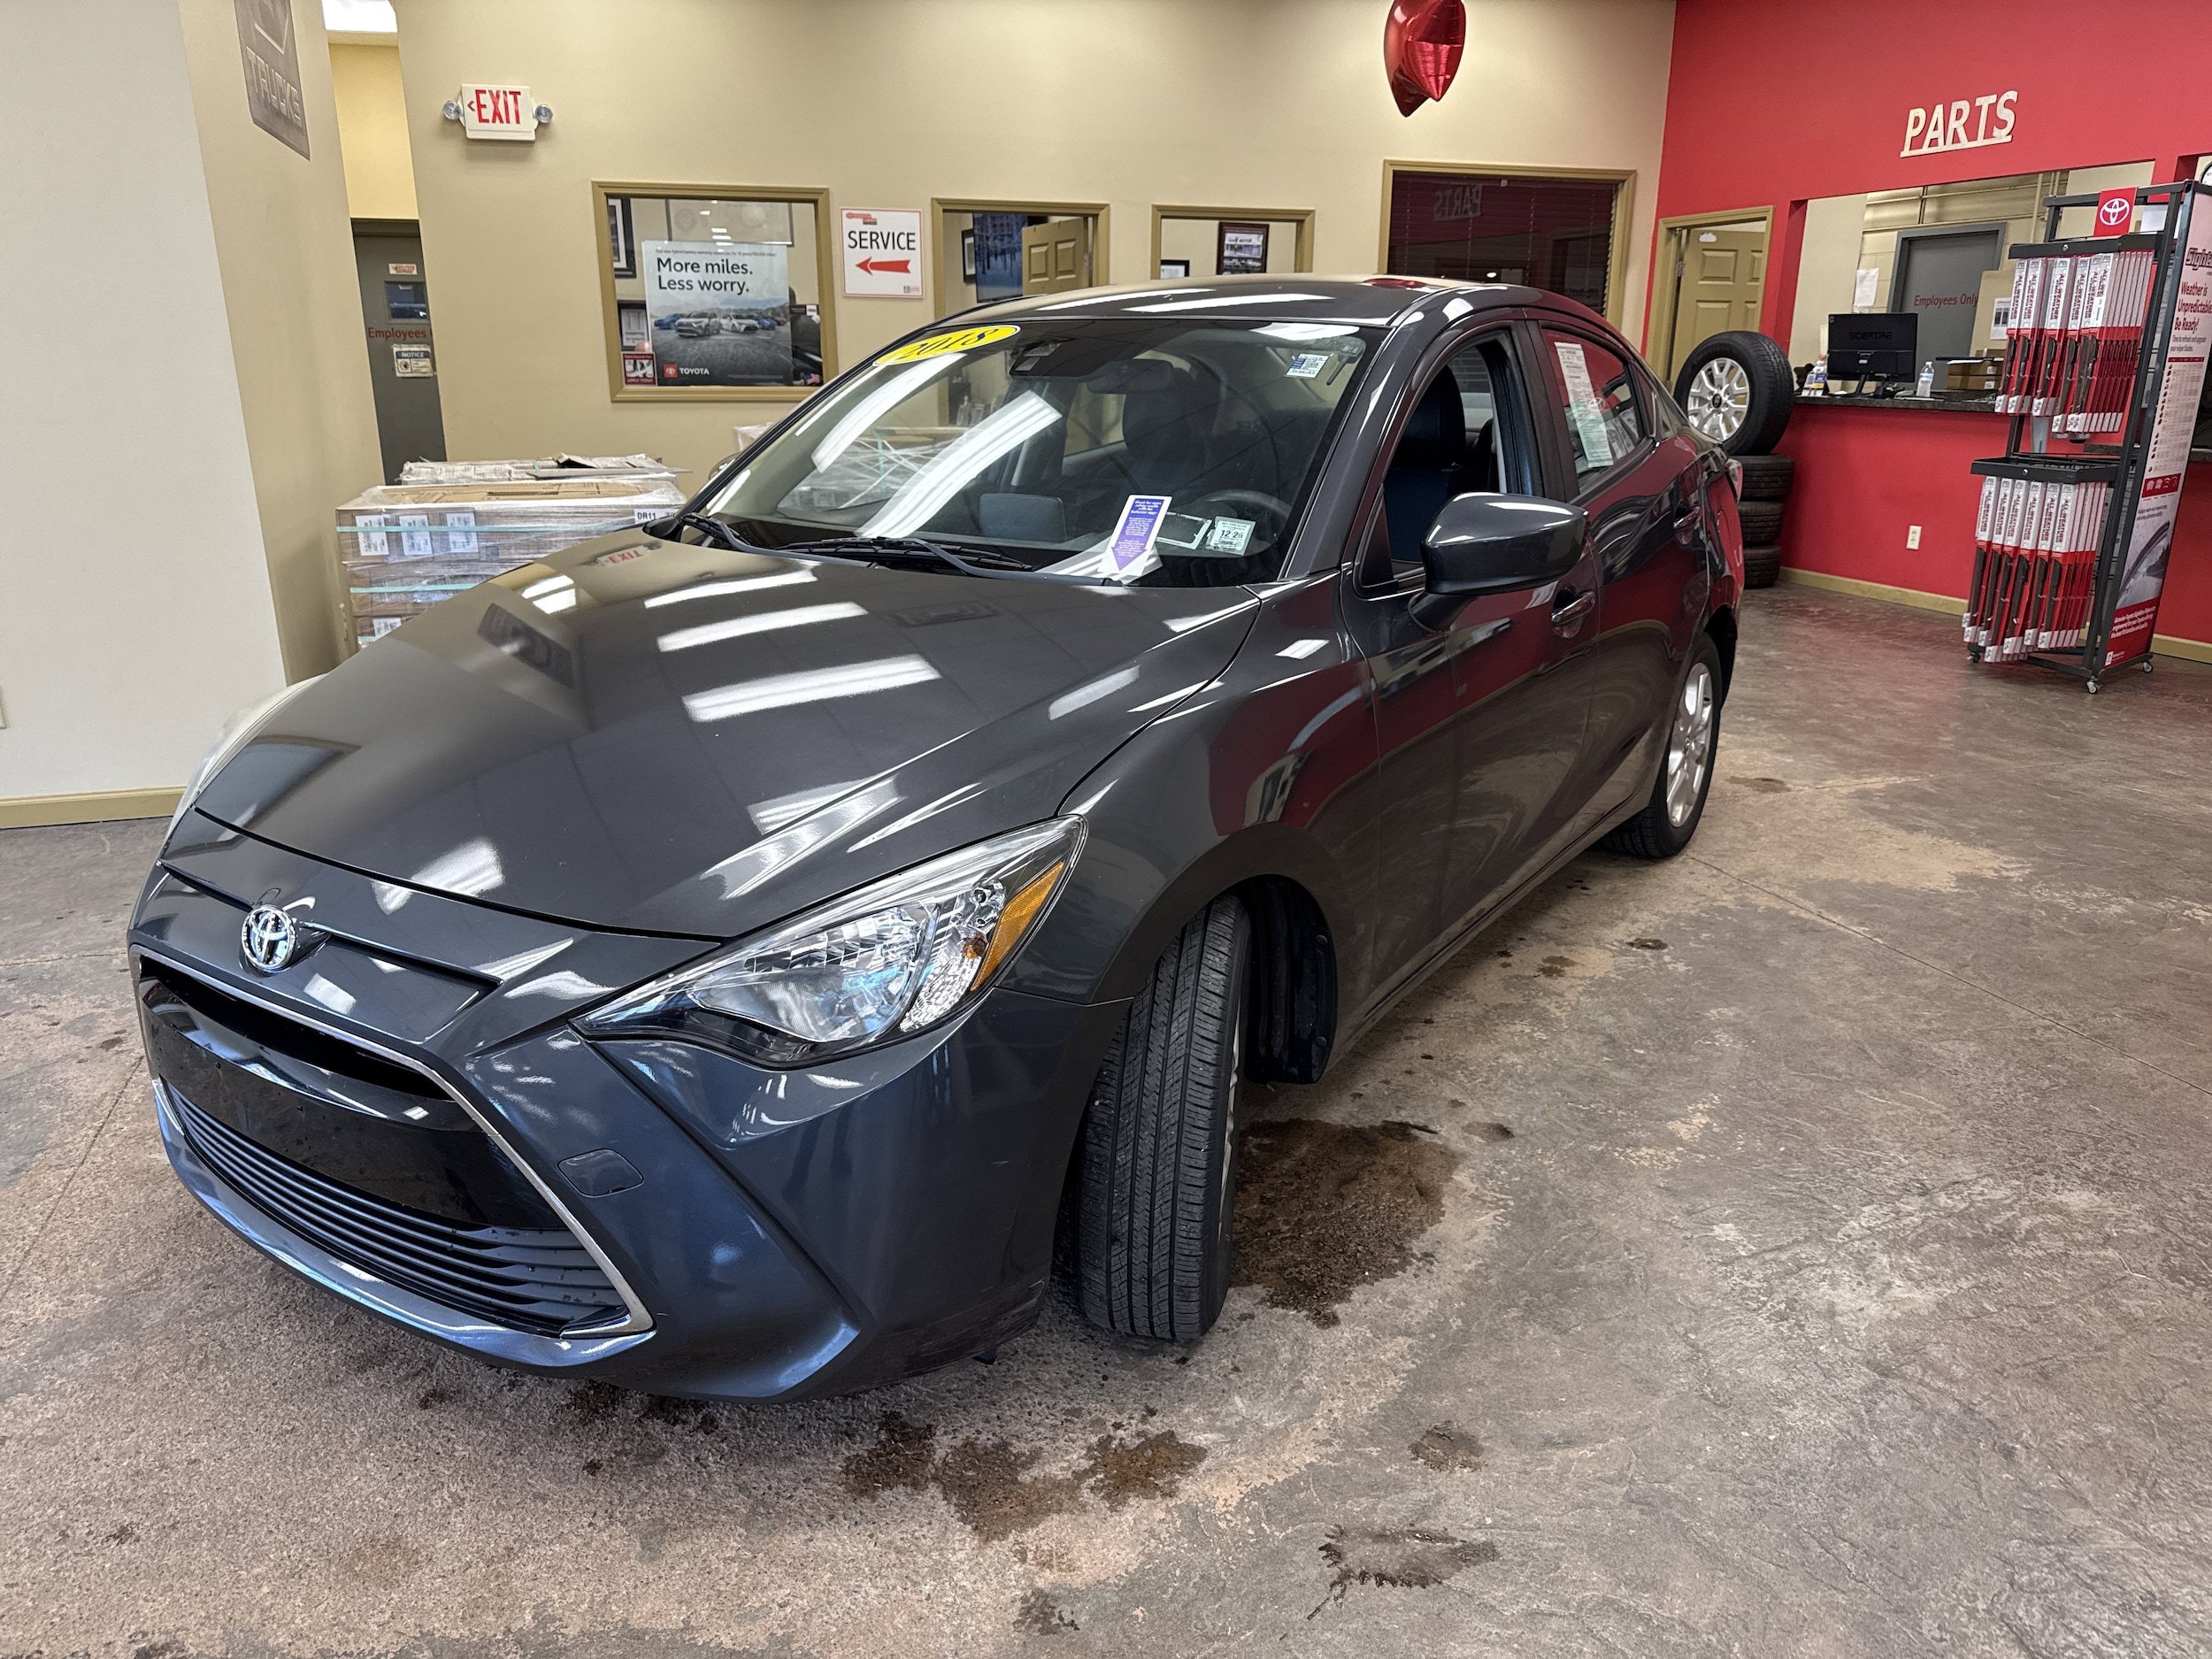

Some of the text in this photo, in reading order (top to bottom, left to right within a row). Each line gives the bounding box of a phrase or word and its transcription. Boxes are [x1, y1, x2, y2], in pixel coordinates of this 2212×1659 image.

[247, 47, 303, 127] TRUCKS
[475, 89, 521, 124] EXIT
[1901, 90, 2018, 156] PARTS
[848, 230, 917, 250] SERVICE
[657, 257, 752, 274] More miles.
[658, 275, 749, 296] Less worry.
[1914, 293, 1978, 309] Employees Only
[2027, 274, 2037, 319] ALL-WEATHER
[2054, 273, 2064, 320] ALL-WEATHER
[2075, 274, 2085, 320] ALL-WEATHER
[2088, 272, 2098, 318] ALL-WEATHER
[2181, 282, 2208, 297] Weather is
[367, 327, 426, 340] Employees
[895, 328, 999, 361] 2018
[2175, 317, 2200, 334] Be Ready!
[2026, 497, 2037, 540] ALL-WEATHER
[2045, 497, 2055, 541] ALL-WEATHER
[2060, 499, 2069, 542] ALL-WEATHER
